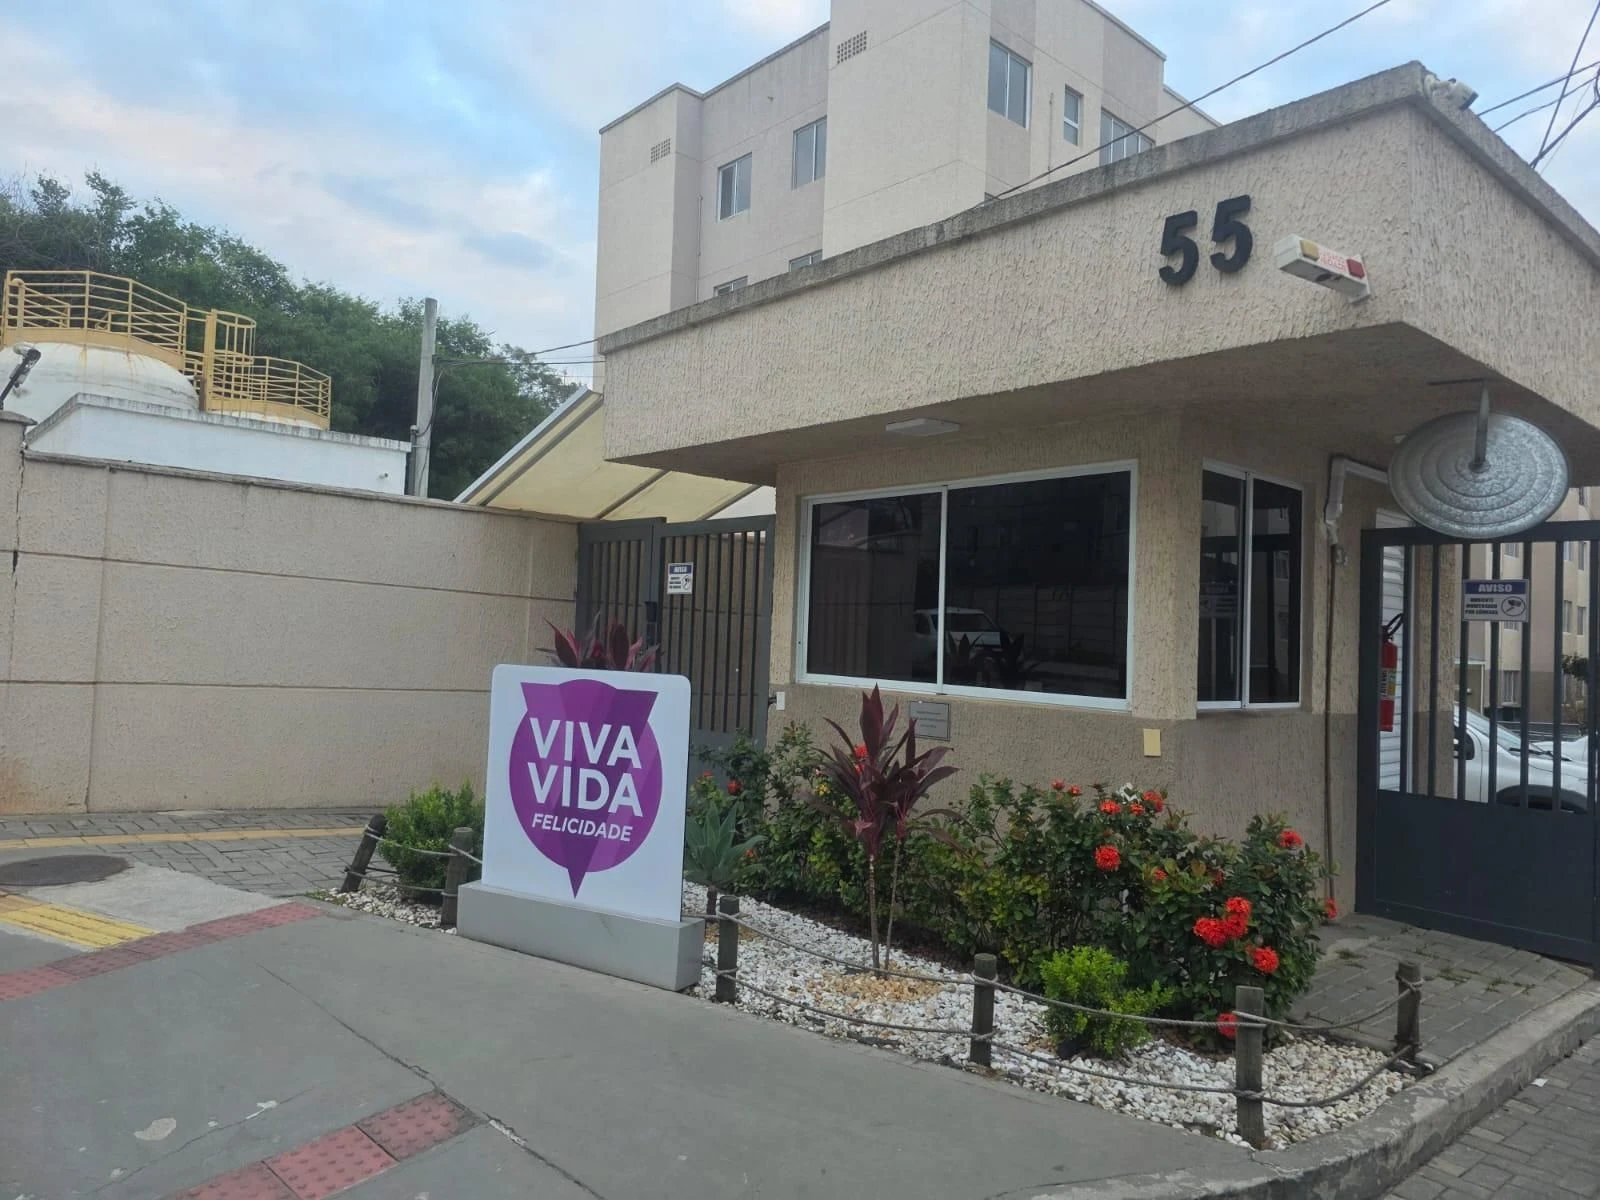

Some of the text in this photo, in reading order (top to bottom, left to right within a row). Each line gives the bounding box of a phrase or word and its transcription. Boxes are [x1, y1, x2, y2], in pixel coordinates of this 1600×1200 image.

[1159, 194, 1253, 286] 55
[1478, 583, 1513, 593] AVISO
[529, 717, 642, 769] VIVA
[527, 762, 643, 817] VIDA
[531, 813, 633, 842] FELICIDADE
